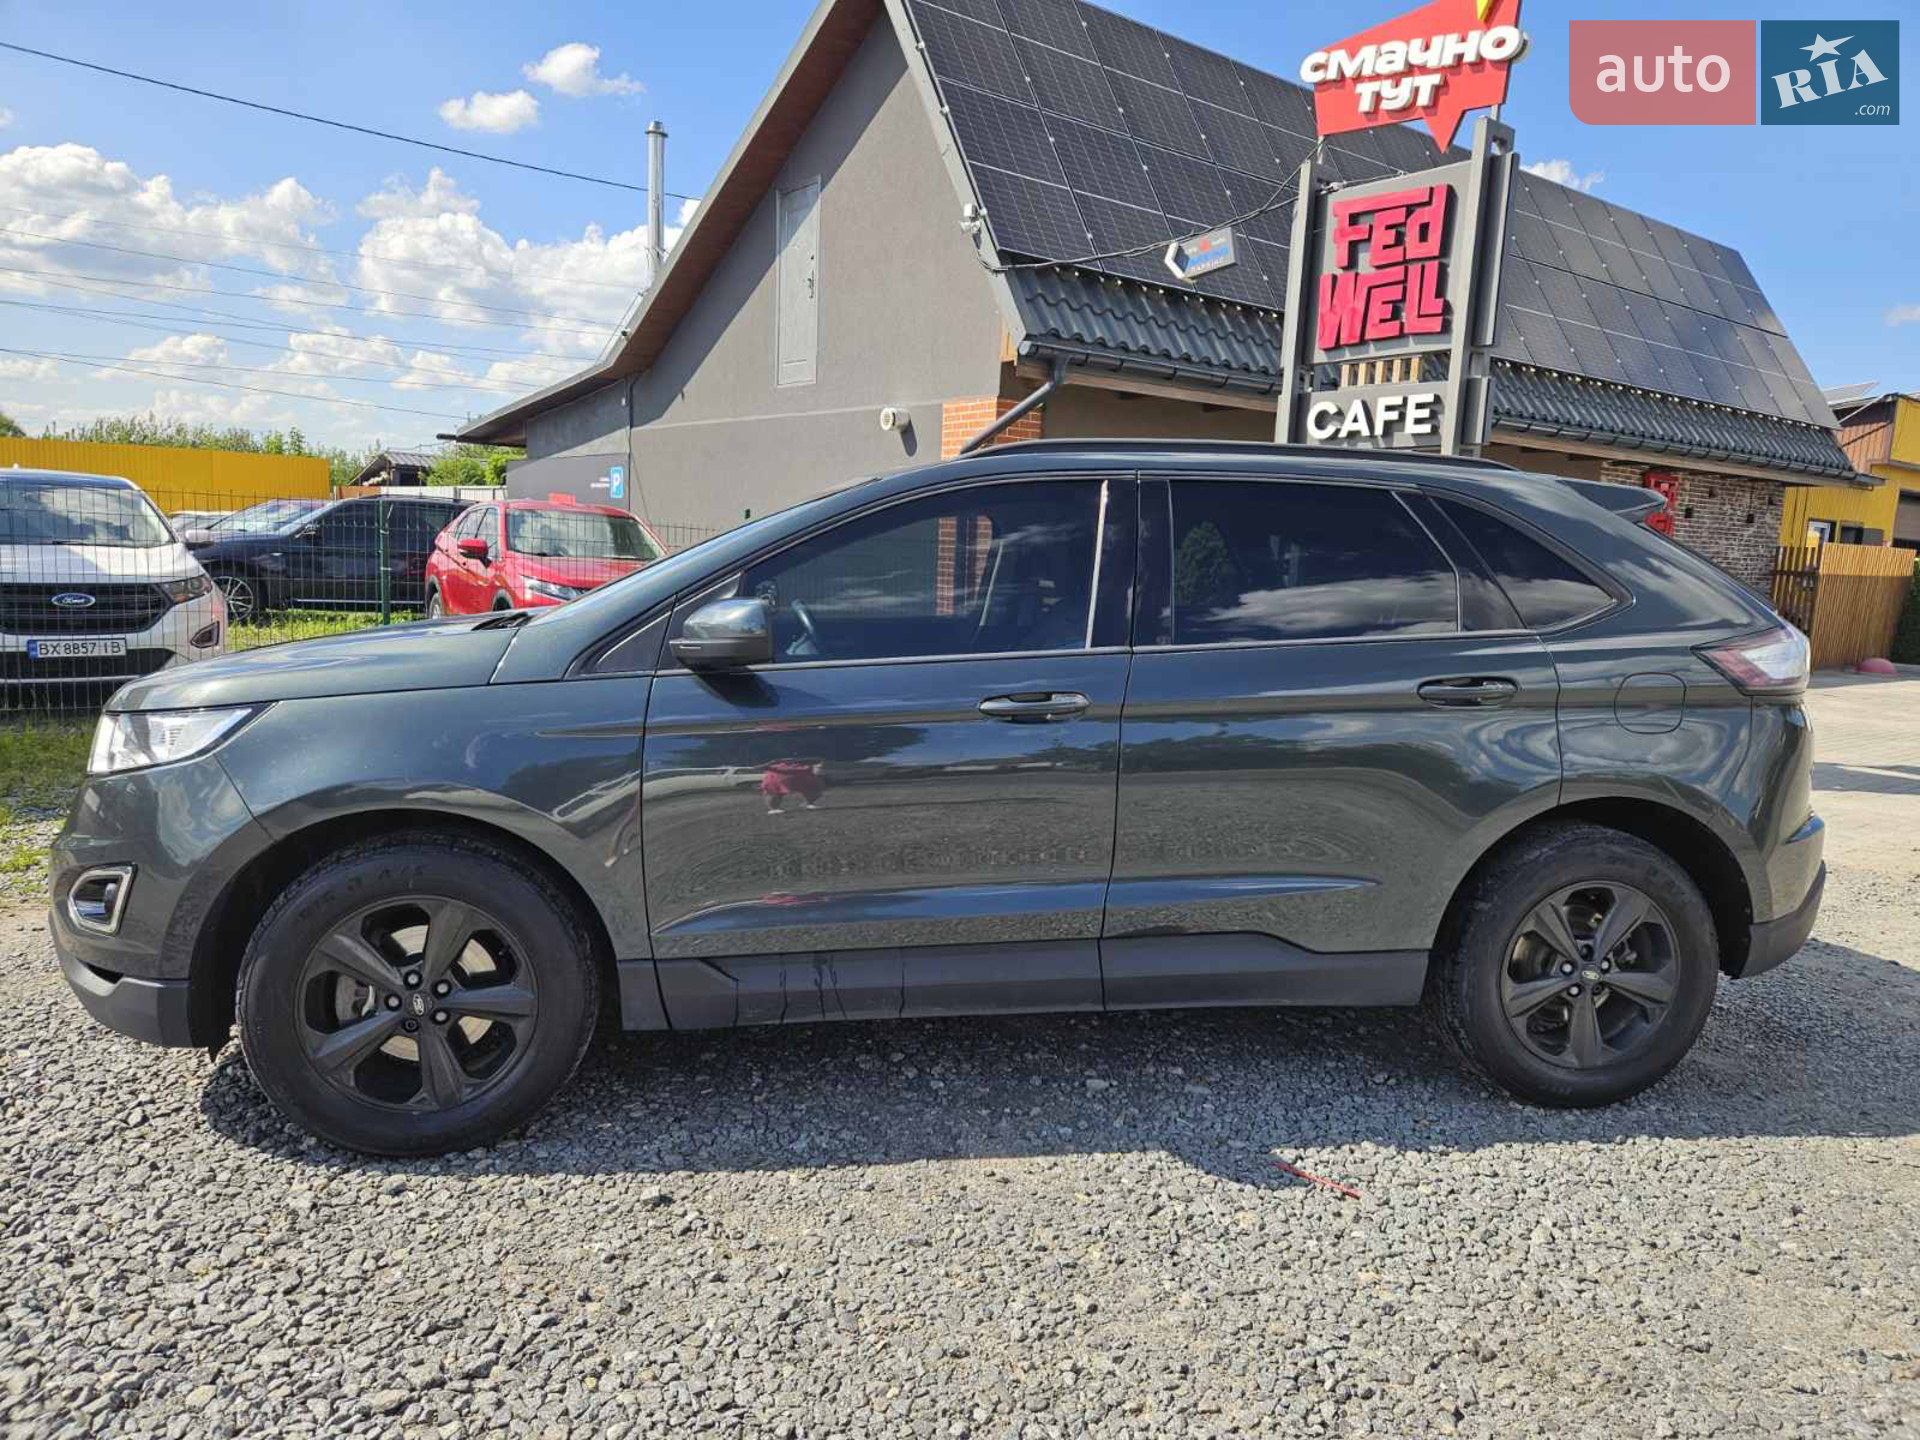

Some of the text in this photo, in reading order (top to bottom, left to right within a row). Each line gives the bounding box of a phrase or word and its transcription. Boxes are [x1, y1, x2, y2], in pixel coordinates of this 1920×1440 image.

[1317, 261, 1445, 350] WELL
[1306, 393, 1435, 440] CAFE
[38, 643, 60, 656] BX
[63, 642, 97, 655] 8857
